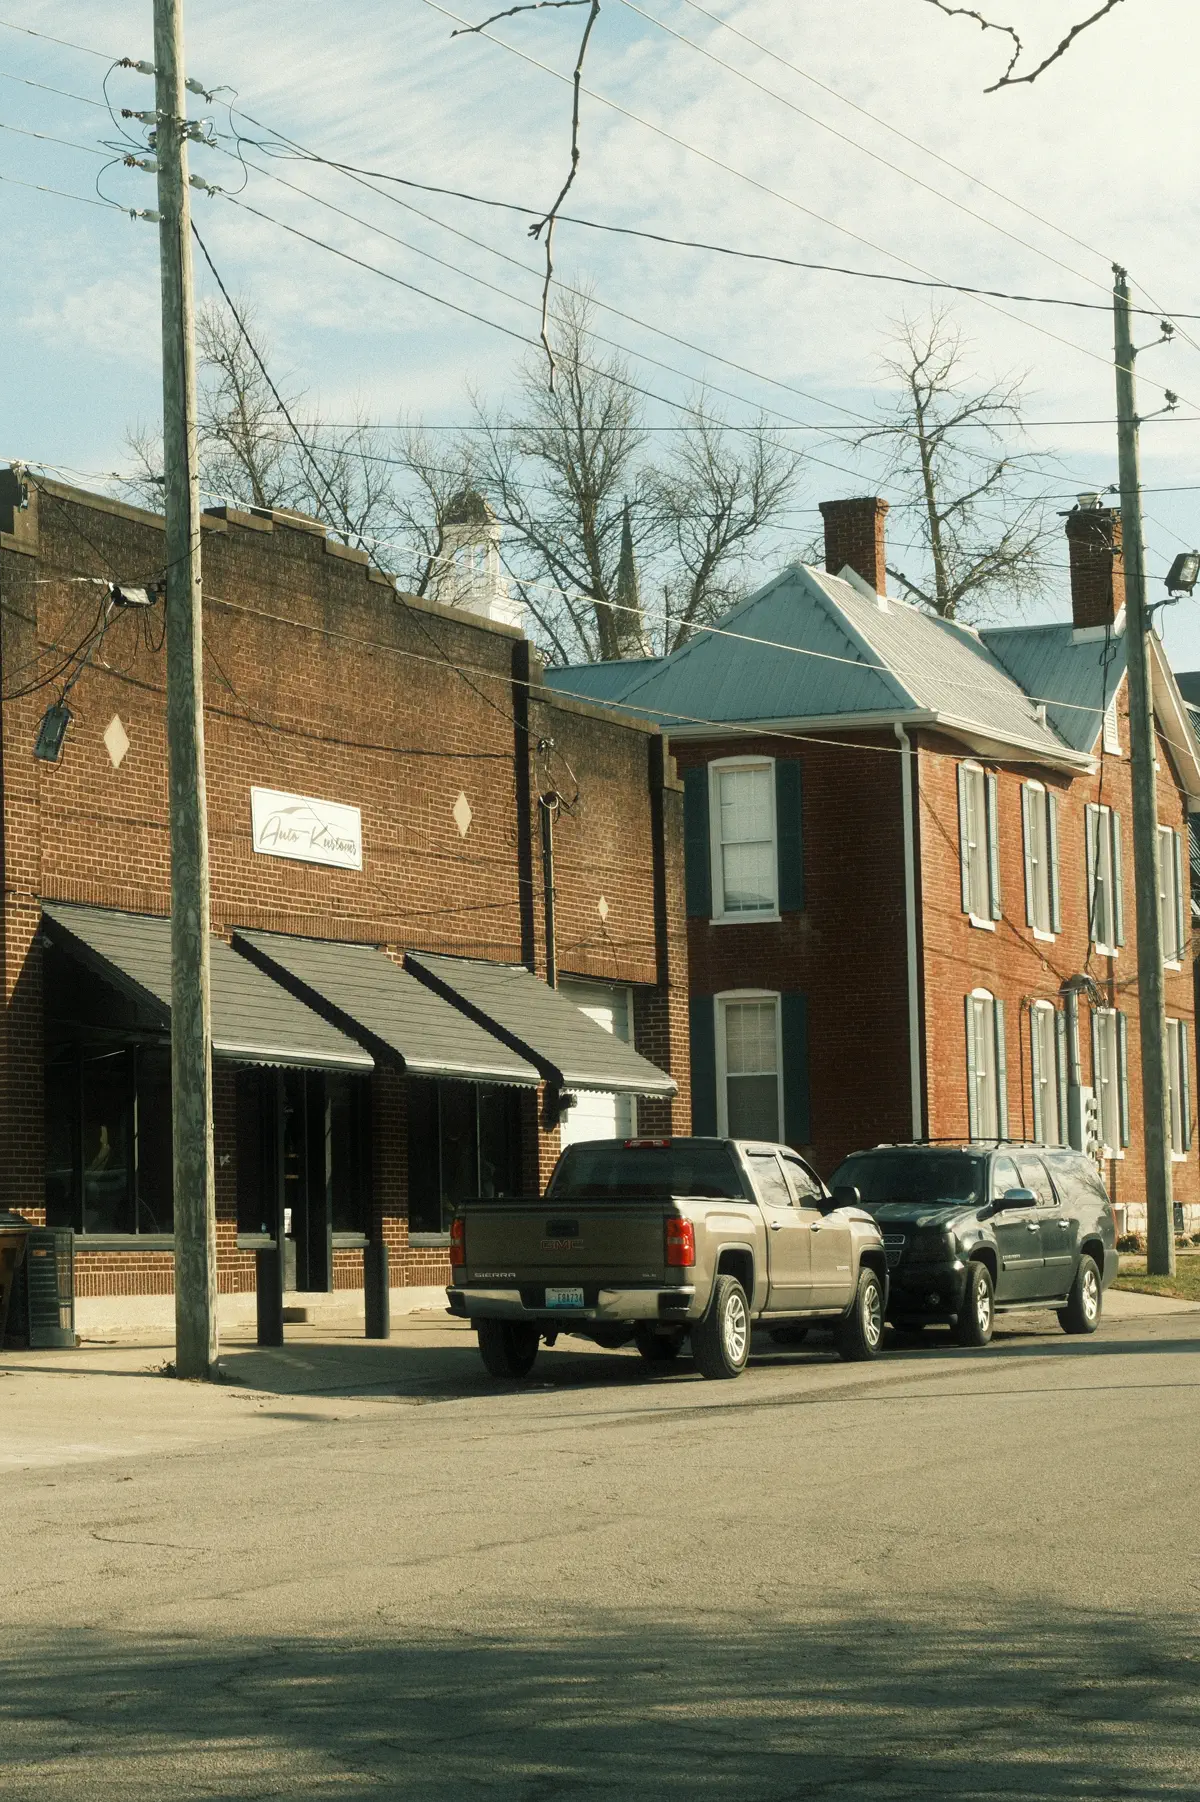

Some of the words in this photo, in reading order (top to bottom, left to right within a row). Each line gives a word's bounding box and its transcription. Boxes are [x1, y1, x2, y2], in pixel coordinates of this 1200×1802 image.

[259, 816, 309, 847] Auto
[309, 824, 357, 856] Kustoms
[540, 1239, 584, 1250] GMC
